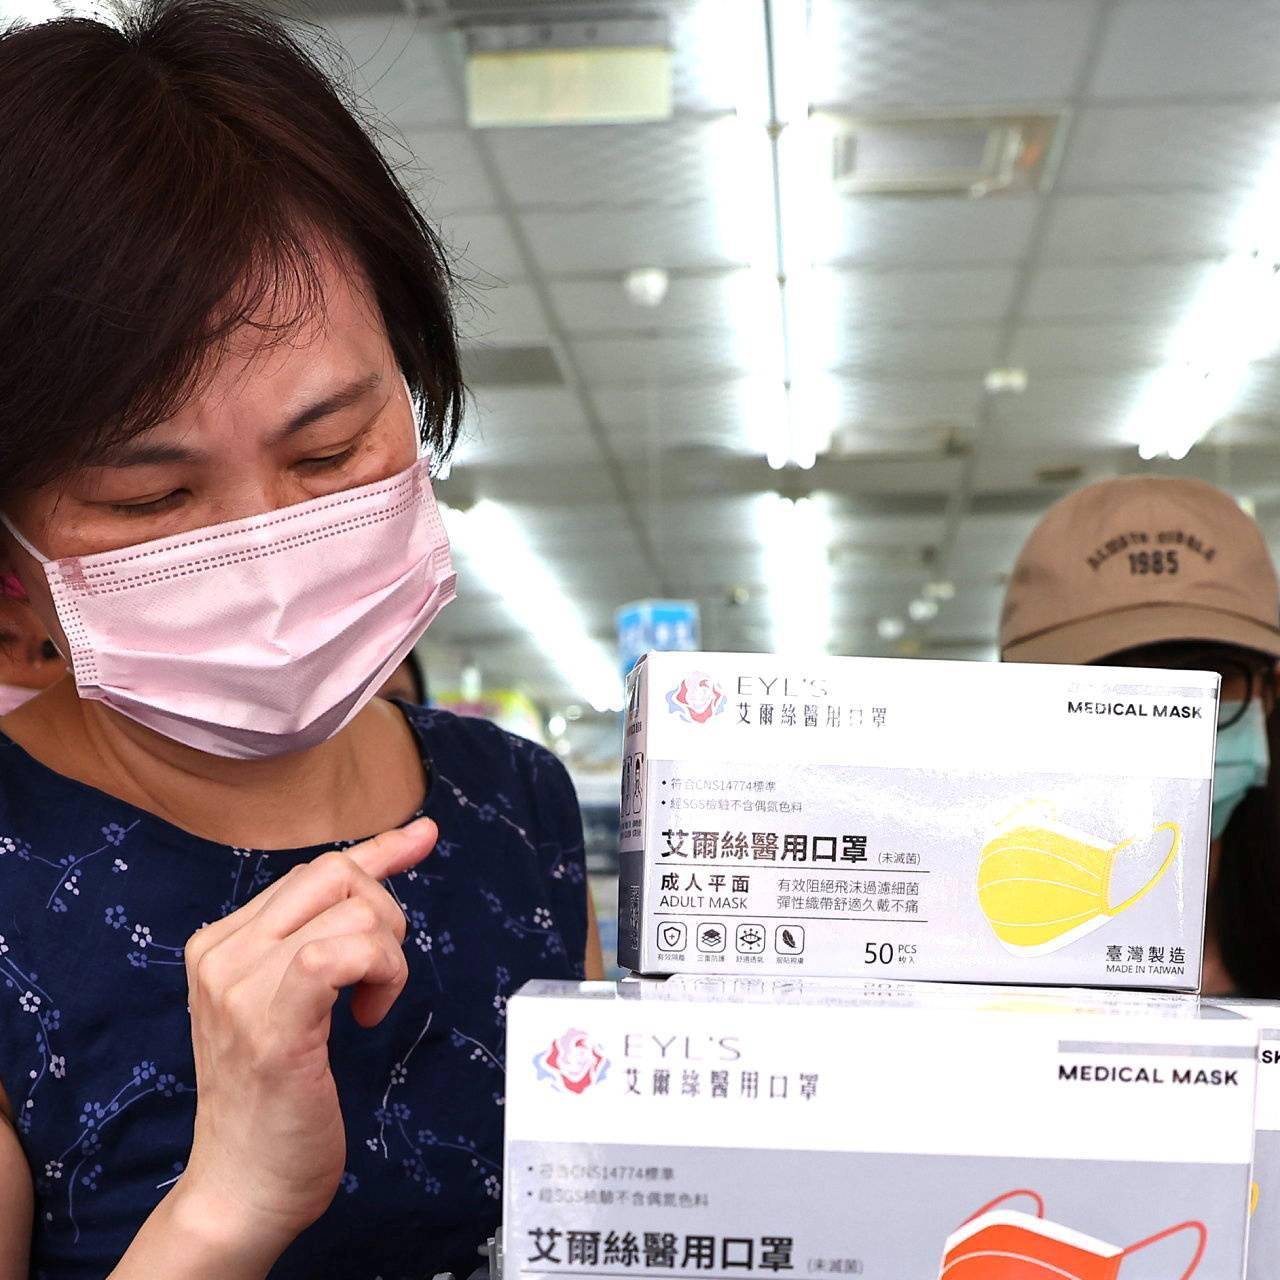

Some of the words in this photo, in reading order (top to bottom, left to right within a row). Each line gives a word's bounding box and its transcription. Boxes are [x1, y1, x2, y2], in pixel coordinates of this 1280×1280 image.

[1128, 551, 1179, 576] 1985
[1067, 701, 1148, 716] MEDICAL
[1152, 704, 1202, 719] MASK
[660, 828, 869, 864] 艾爾絲醫用口罩
[660, 873, 750, 894] 成人平面
[776, 878, 920, 897] 有效阻絕飛沫過濾細菌
[659, 896, 704, 909] ADULT
[708, 897, 748, 910] MASK
[863, 942, 894, 965] 50
[898, 944, 917, 955] PCS
[1105, 945, 1186, 964] 臺灣製造
[1106, 964, 1133, 974] MADE
[1135, 965, 1146, 974] IN
[1147, 965, 1185, 975] TAIWAN
[623, 1033, 742, 1062] EYL'S
[624, 1067, 819, 1101] 艾爾絲醫用口罩
[1057, 1064, 1164, 1084] MEDICAL
[1171, 1068, 1239, 1087] MASK
[526, 1226, 795, 1273] 艾爾絲醫用口罩
